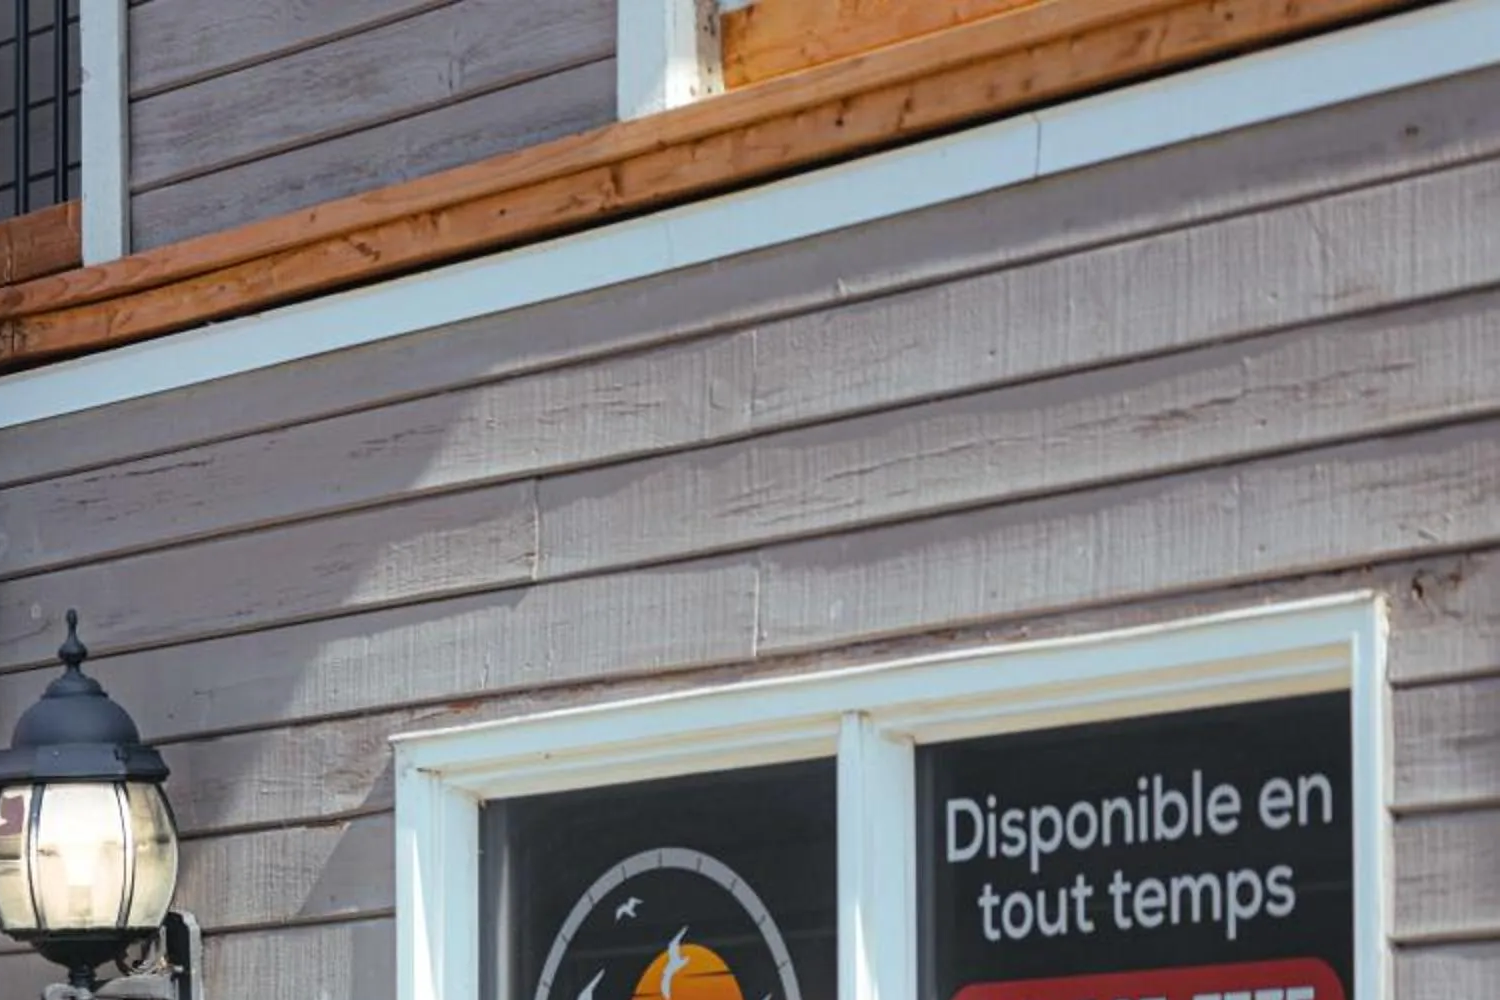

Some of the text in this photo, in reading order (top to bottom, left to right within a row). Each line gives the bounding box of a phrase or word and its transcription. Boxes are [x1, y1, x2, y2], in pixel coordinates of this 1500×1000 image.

[945, 769, 1334, 874] Disponible en
[978, 864, 1296, 942] tout temps
